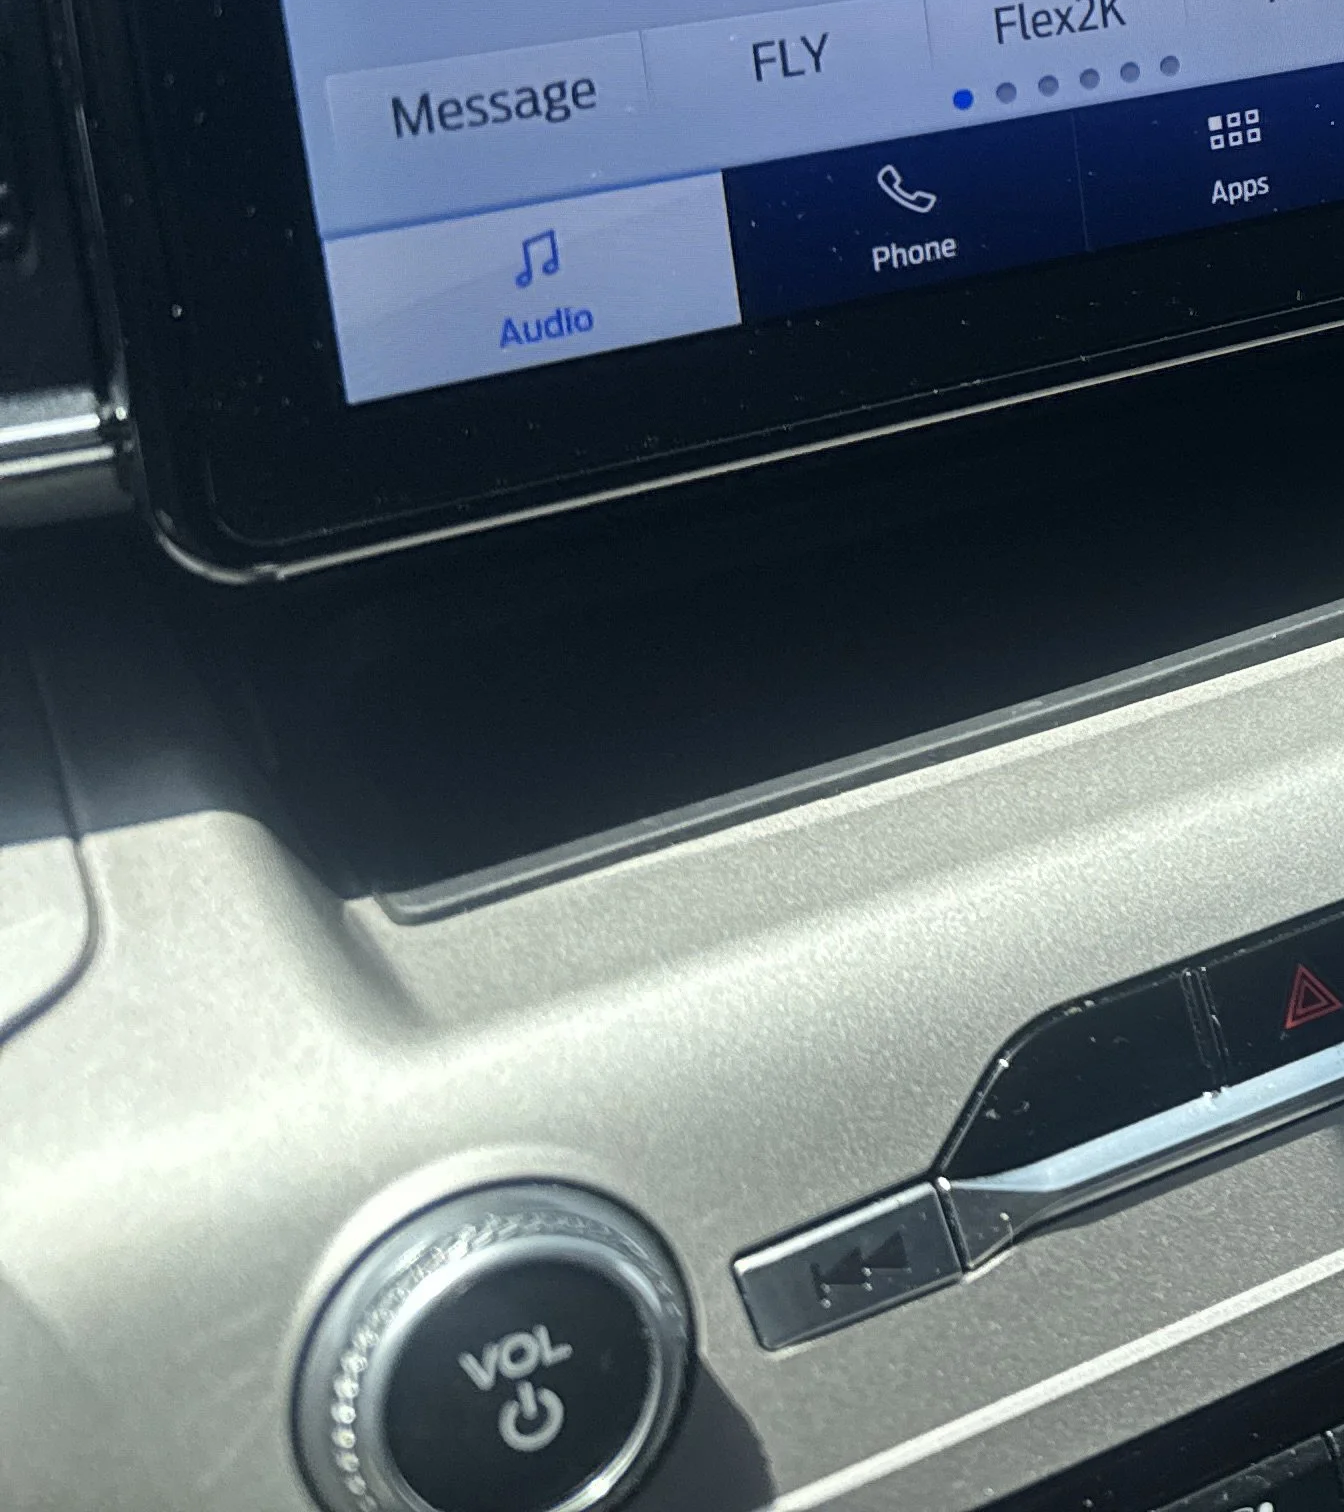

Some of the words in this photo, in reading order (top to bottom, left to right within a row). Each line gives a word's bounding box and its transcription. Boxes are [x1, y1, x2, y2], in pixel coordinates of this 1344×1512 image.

[750, 32, 831, 83] FLY
[390, 74, 598, 140] Message
[1209, 171, 1271, 206] Apps
[870, 234, 958, 273] Phone
[499, 304, 595, 349] Audio
[457, 1323, 574, 1390] VOL
